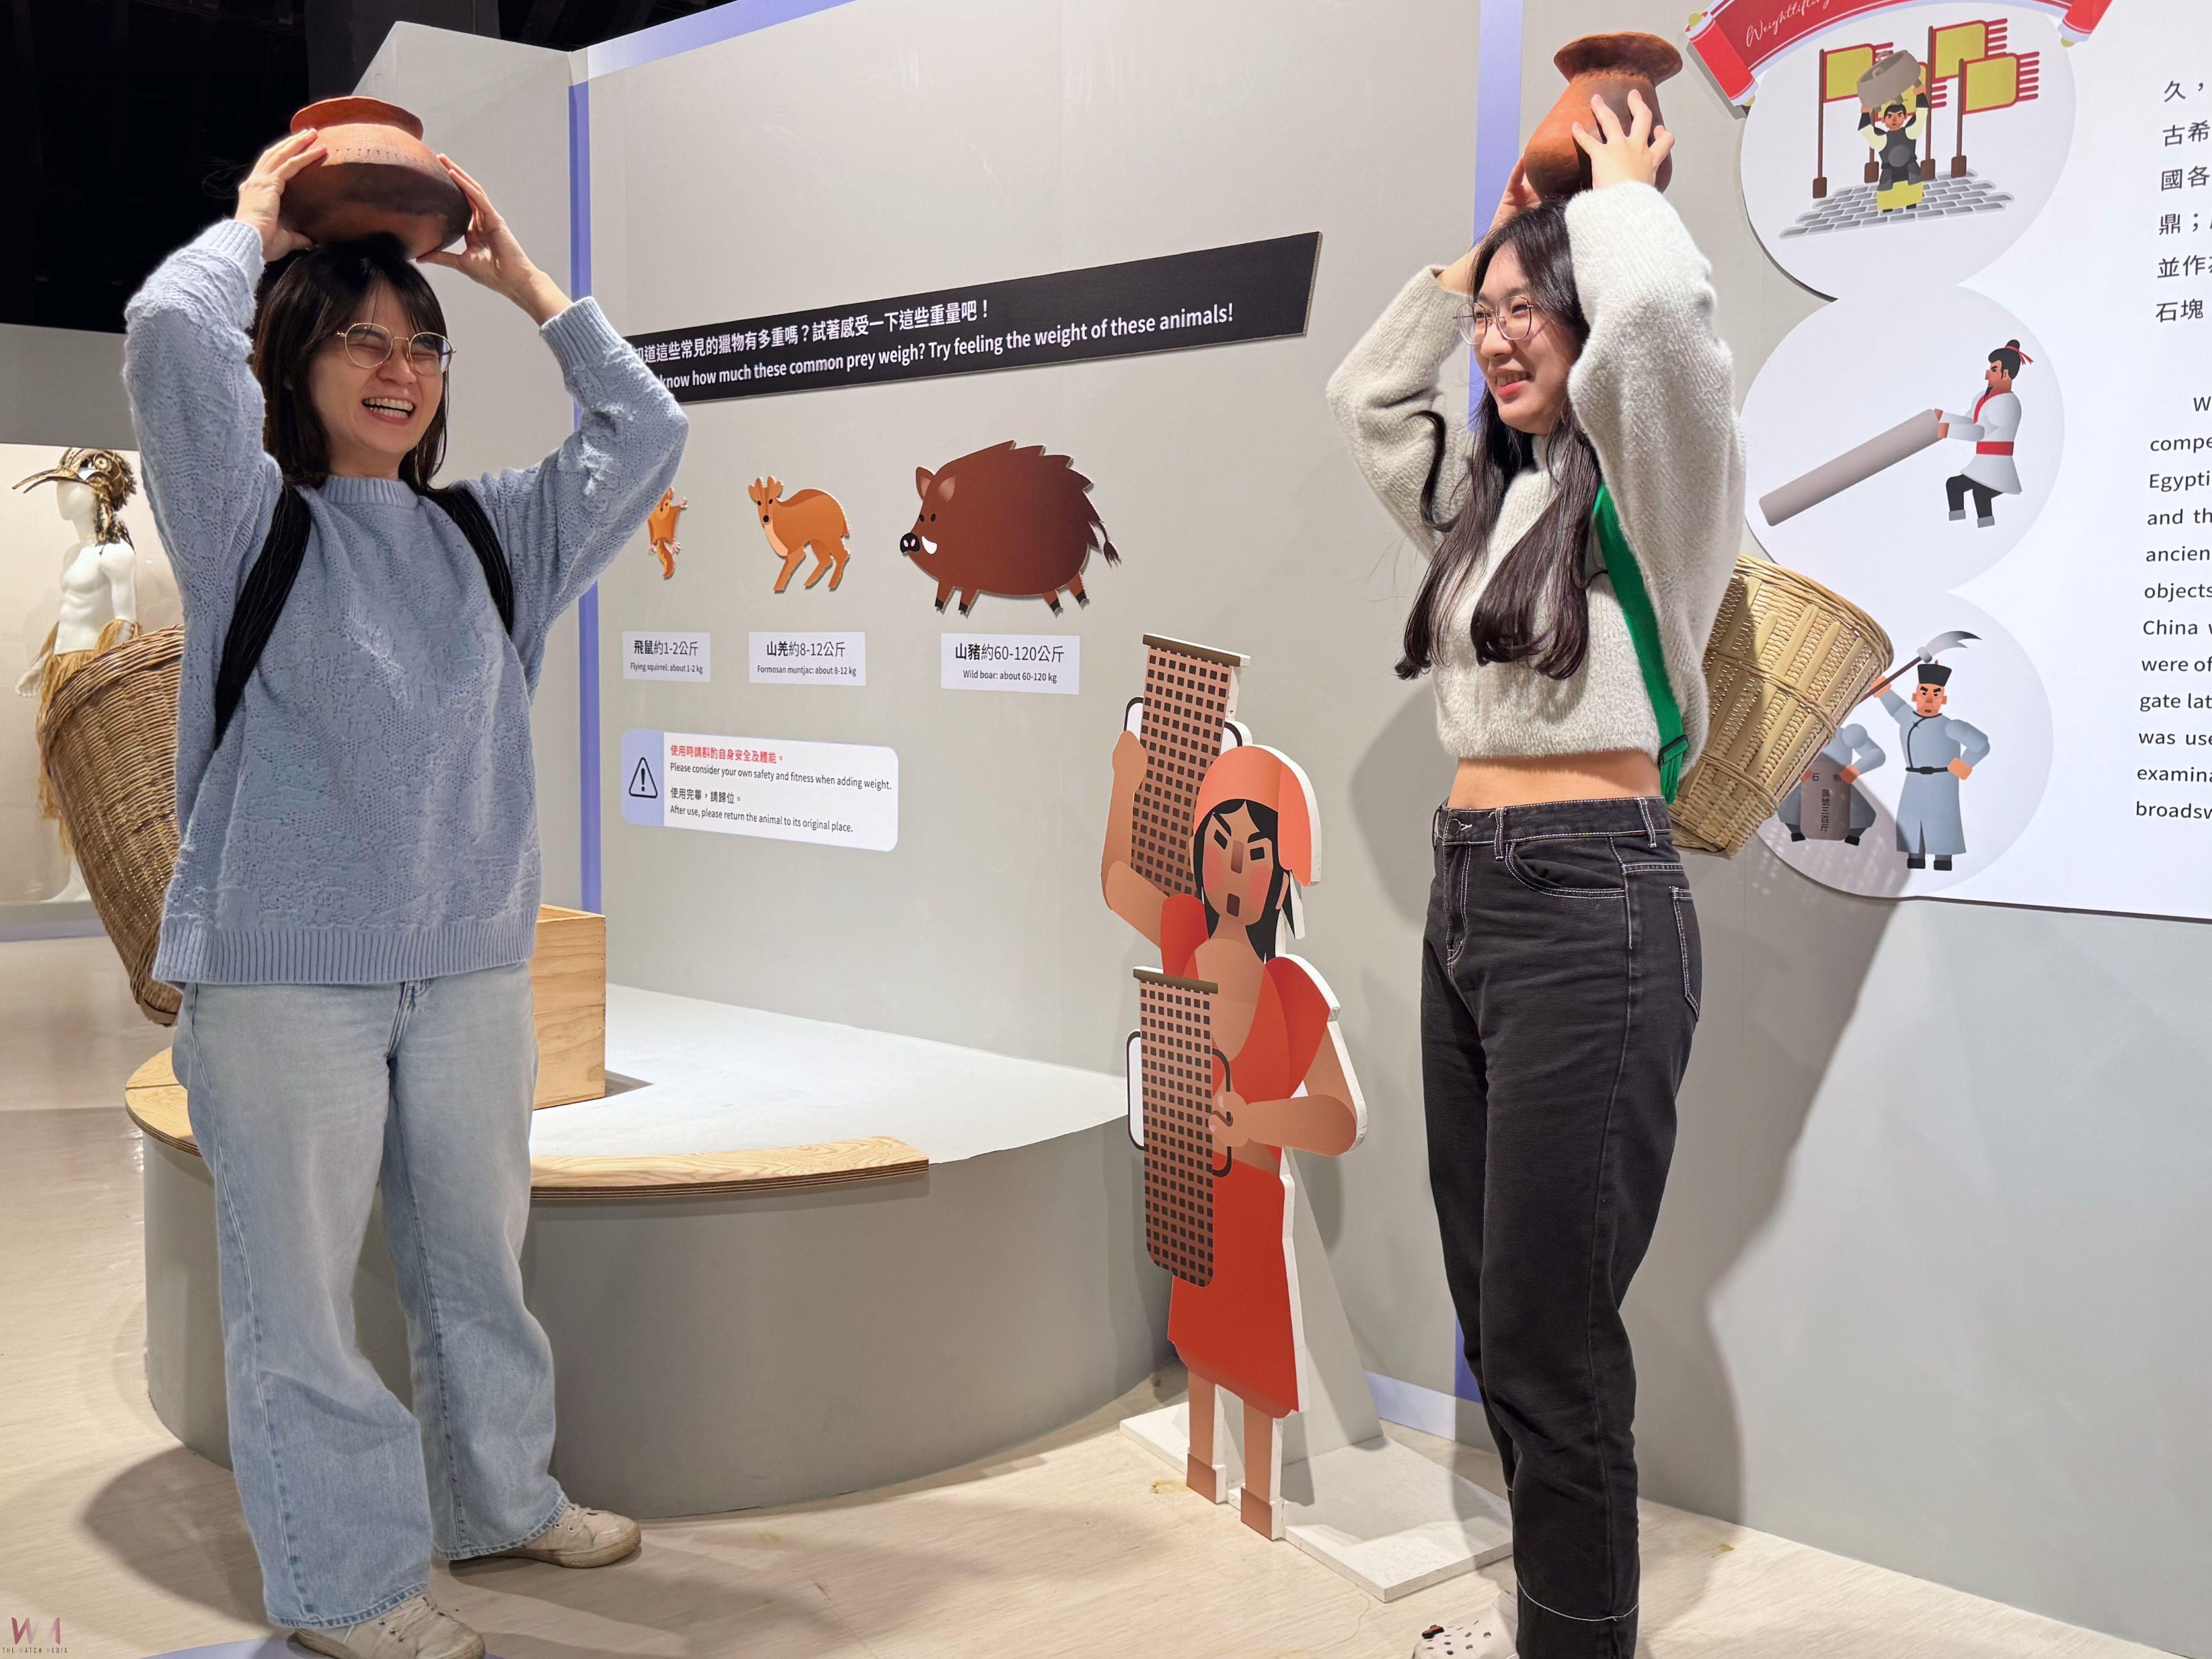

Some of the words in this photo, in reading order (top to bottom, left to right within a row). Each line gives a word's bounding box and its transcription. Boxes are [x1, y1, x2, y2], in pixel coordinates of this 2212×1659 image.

[2163, 120, 2210, 146] 古希
[2161, 165, 2210, 191] 國各
[2159, 213, 2212, 235] 鼎；
[2156, 299, 2203, 322] 石塊
[693, 370, 716, 386] how
[719, 364, 751, 383] much
[754, 362, 787, 378] these
[789, 357, 843, 374] common
[847, 352, 875, 371] prey
[879, 343, 925, 366] weigh?
[928, 342, 951, 361] Try
[954, 334, 1003, 355] feeling
[1006, 331, 1031, 349] the
[1035, 322, 1088, 347] weight
[1091, 319, 1108, 338] of
[1111, 317, 1155, 335] these
[1159, 303, 1233, 330] animals!
[2147, 509, 2183, 525] and
[2146, 546, 2212, 562] ancien
[2143, 620, 2198, 636] China
[634, 640, 698, 656] 飛鼠約1-2公斤
[955, 643, 1064, 663] 山豬約60-120公斤
[631, 662, 646, 672] Flying
[670, 664, 686, 672] about
[696, 665, 703, 674] kg
[757, 665, 786, 674] Formosan
[788, 665, 814, 675] muntjac:
[815, 666, 833, 674] about
[849, 666, 856, 676] kg
[2142, 658, 2188, 672] were
[963, 670, 978, 678] Wild
[980, 671, 998, 679] boar:
[1000, 672, 1020, 680] about
[1022, 673, 1046, 681] 60-120
[1048, 673, 1057, 684] kg
[2140, 695, 2181, 711] gate
[2139, 732, 2176, 745] was
[671, 762, 691, 773] Please
[693, 764, 720, 775] consider
[721, 769, 736, 777] your
[738, 769, 752, 777] own
[754, 769, 774, 781] safety
[776, 772, 789, 780] and
[791, 772, 814, 783] fitness
[815, 775, 835, 785] when
[837, 776, 862, 790] adding
[864, 778, 892, 791] weight.
[671, 805, 686, 815] After
[688, 809, 700, 818] use,
[702, 808, 722, 818] please
[724, 811, 745, 821] return
[747, 813, 757, 822] the
[759, 815, 783, 825] animal
[784, 817, 791, 826] to
[793, 817, 801, 827] its
[803, 818, 830, 831] original
[832, 822, 853, 833] place.
